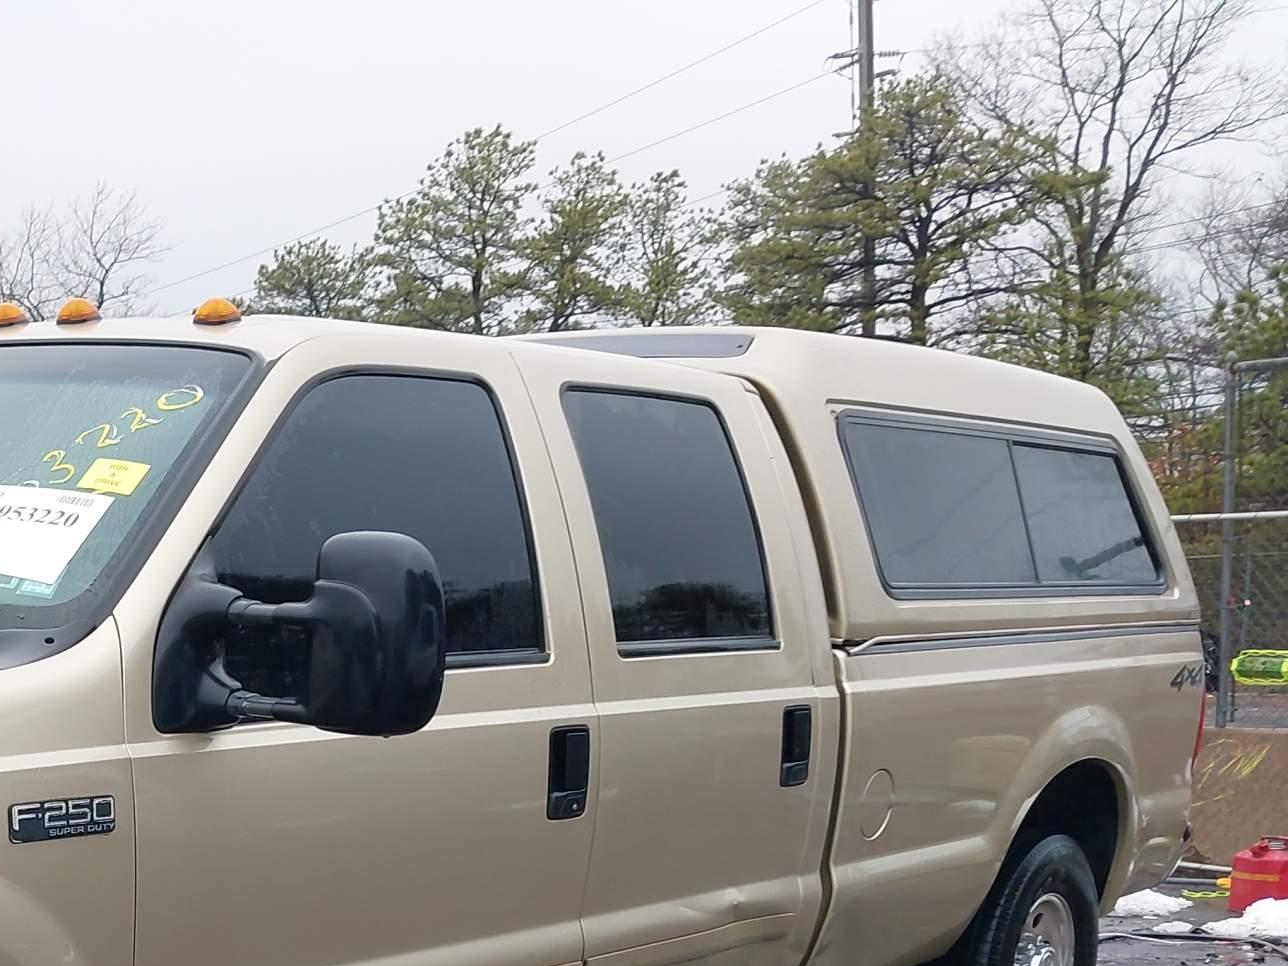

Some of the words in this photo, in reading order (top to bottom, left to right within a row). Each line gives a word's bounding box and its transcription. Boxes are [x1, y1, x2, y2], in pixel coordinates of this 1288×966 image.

[18, 384, 205, 488] 3220
[49, 824, 85, 837] SUPER
[87, 822, 115, 832] DUTY
